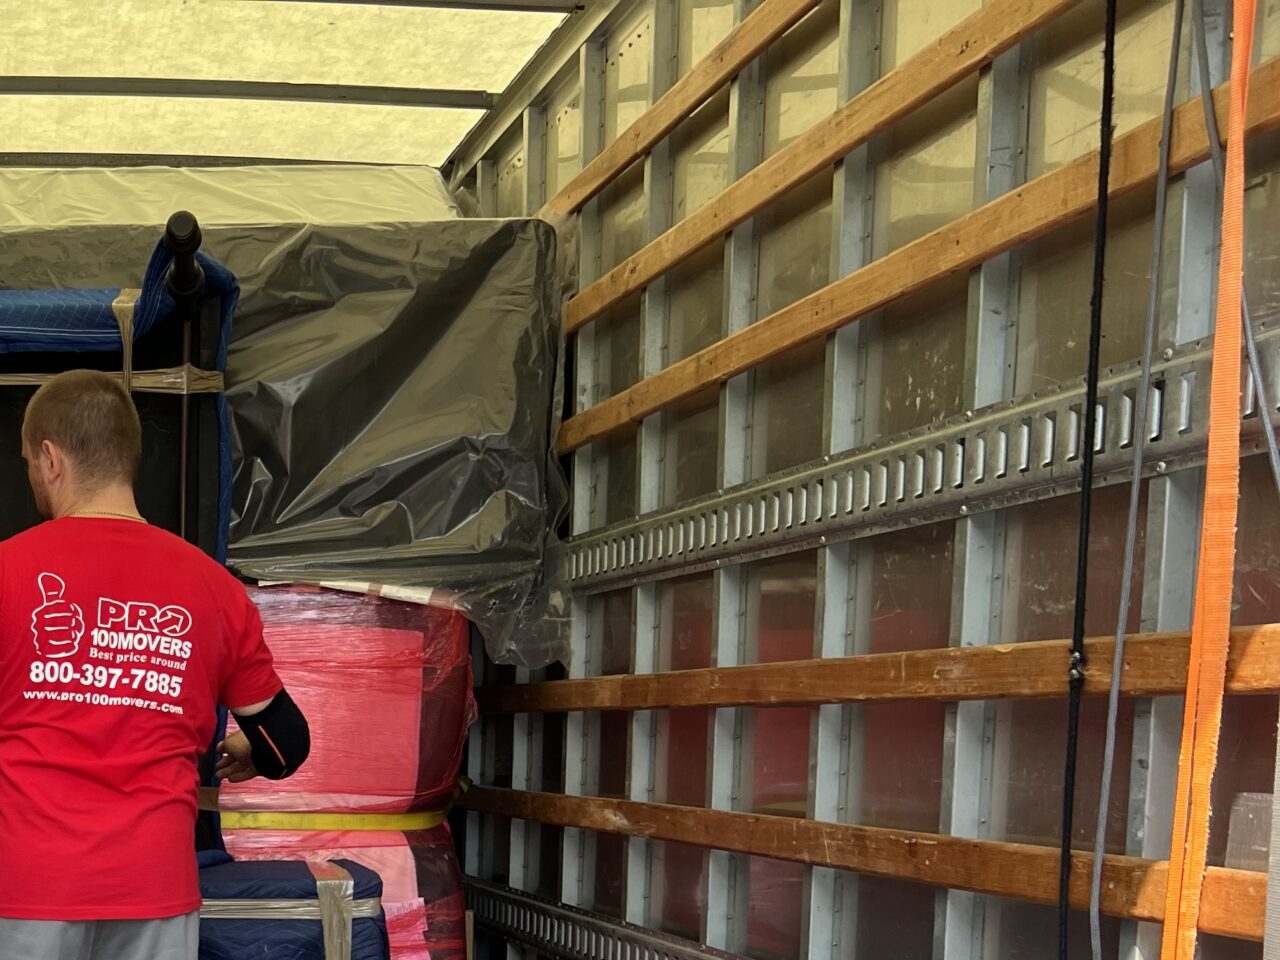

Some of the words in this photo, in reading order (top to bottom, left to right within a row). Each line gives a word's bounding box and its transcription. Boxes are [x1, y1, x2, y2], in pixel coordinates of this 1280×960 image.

[98, 597, 193, 637] PRO
[89, 647, 114, 661] Best
[116, 650, 147, 664] price
[150, 655, 188, 671] around
[91, 628, 193, 659] 100MOVERS
[29, 661, 183, 698] 800-397-7885
[23, 690, 184, 715] www.pro100movers.com
